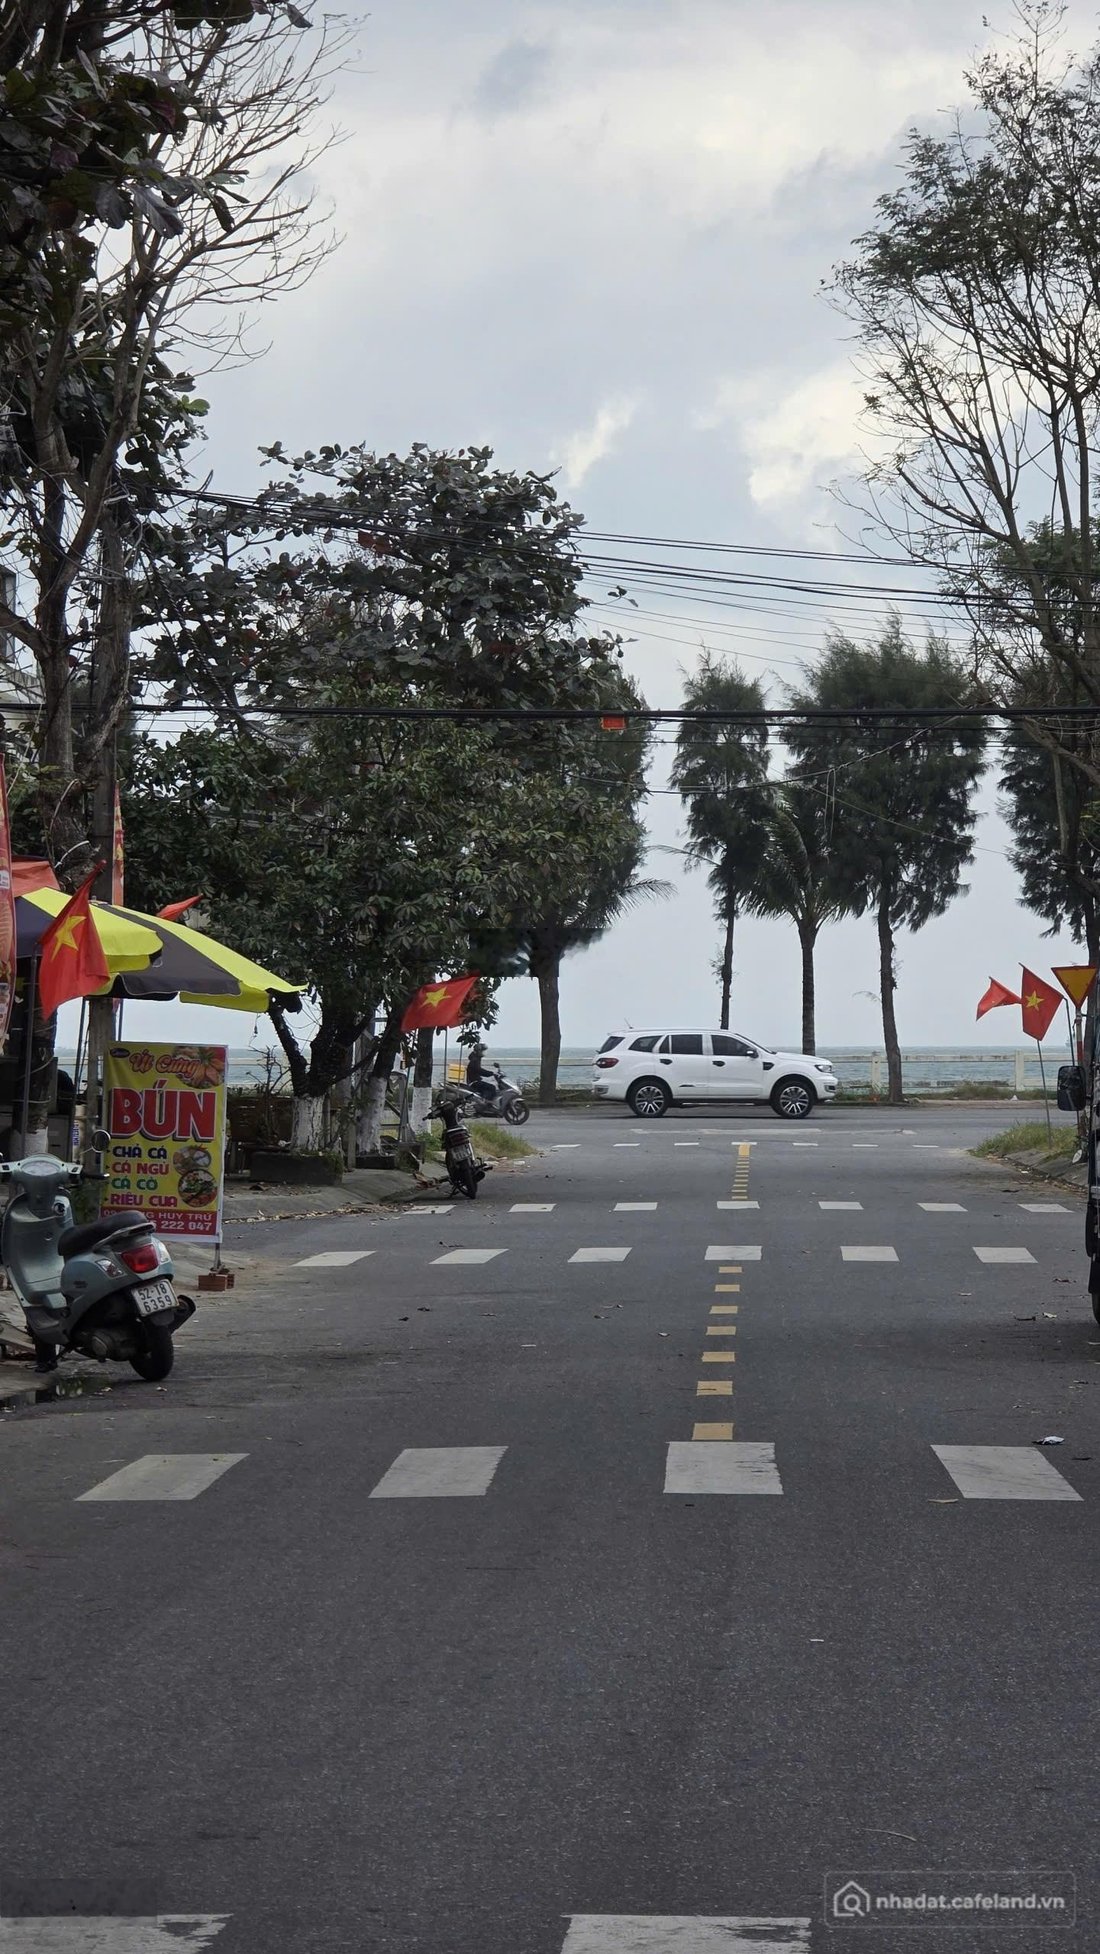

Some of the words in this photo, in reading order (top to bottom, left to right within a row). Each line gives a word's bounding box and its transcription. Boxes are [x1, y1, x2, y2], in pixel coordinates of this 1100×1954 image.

[110, 1079, 216, 1140] BÚN
[112, 1143, 142, 1158] CHẢ
[147, 1145, 167, 1159] CÁ
[111, 1160, 131, 1173] CÁ
[111, 1175, 131, 1189] CÁ
[110, 1191, 144, 1205] RIÊU
[148, 1195, 178, 1207] CUA
[158, 1212, 184, 1220] HUY
[160, 1221, 185, 1230] 222
[143, 1295, 172, 1312] 6359
